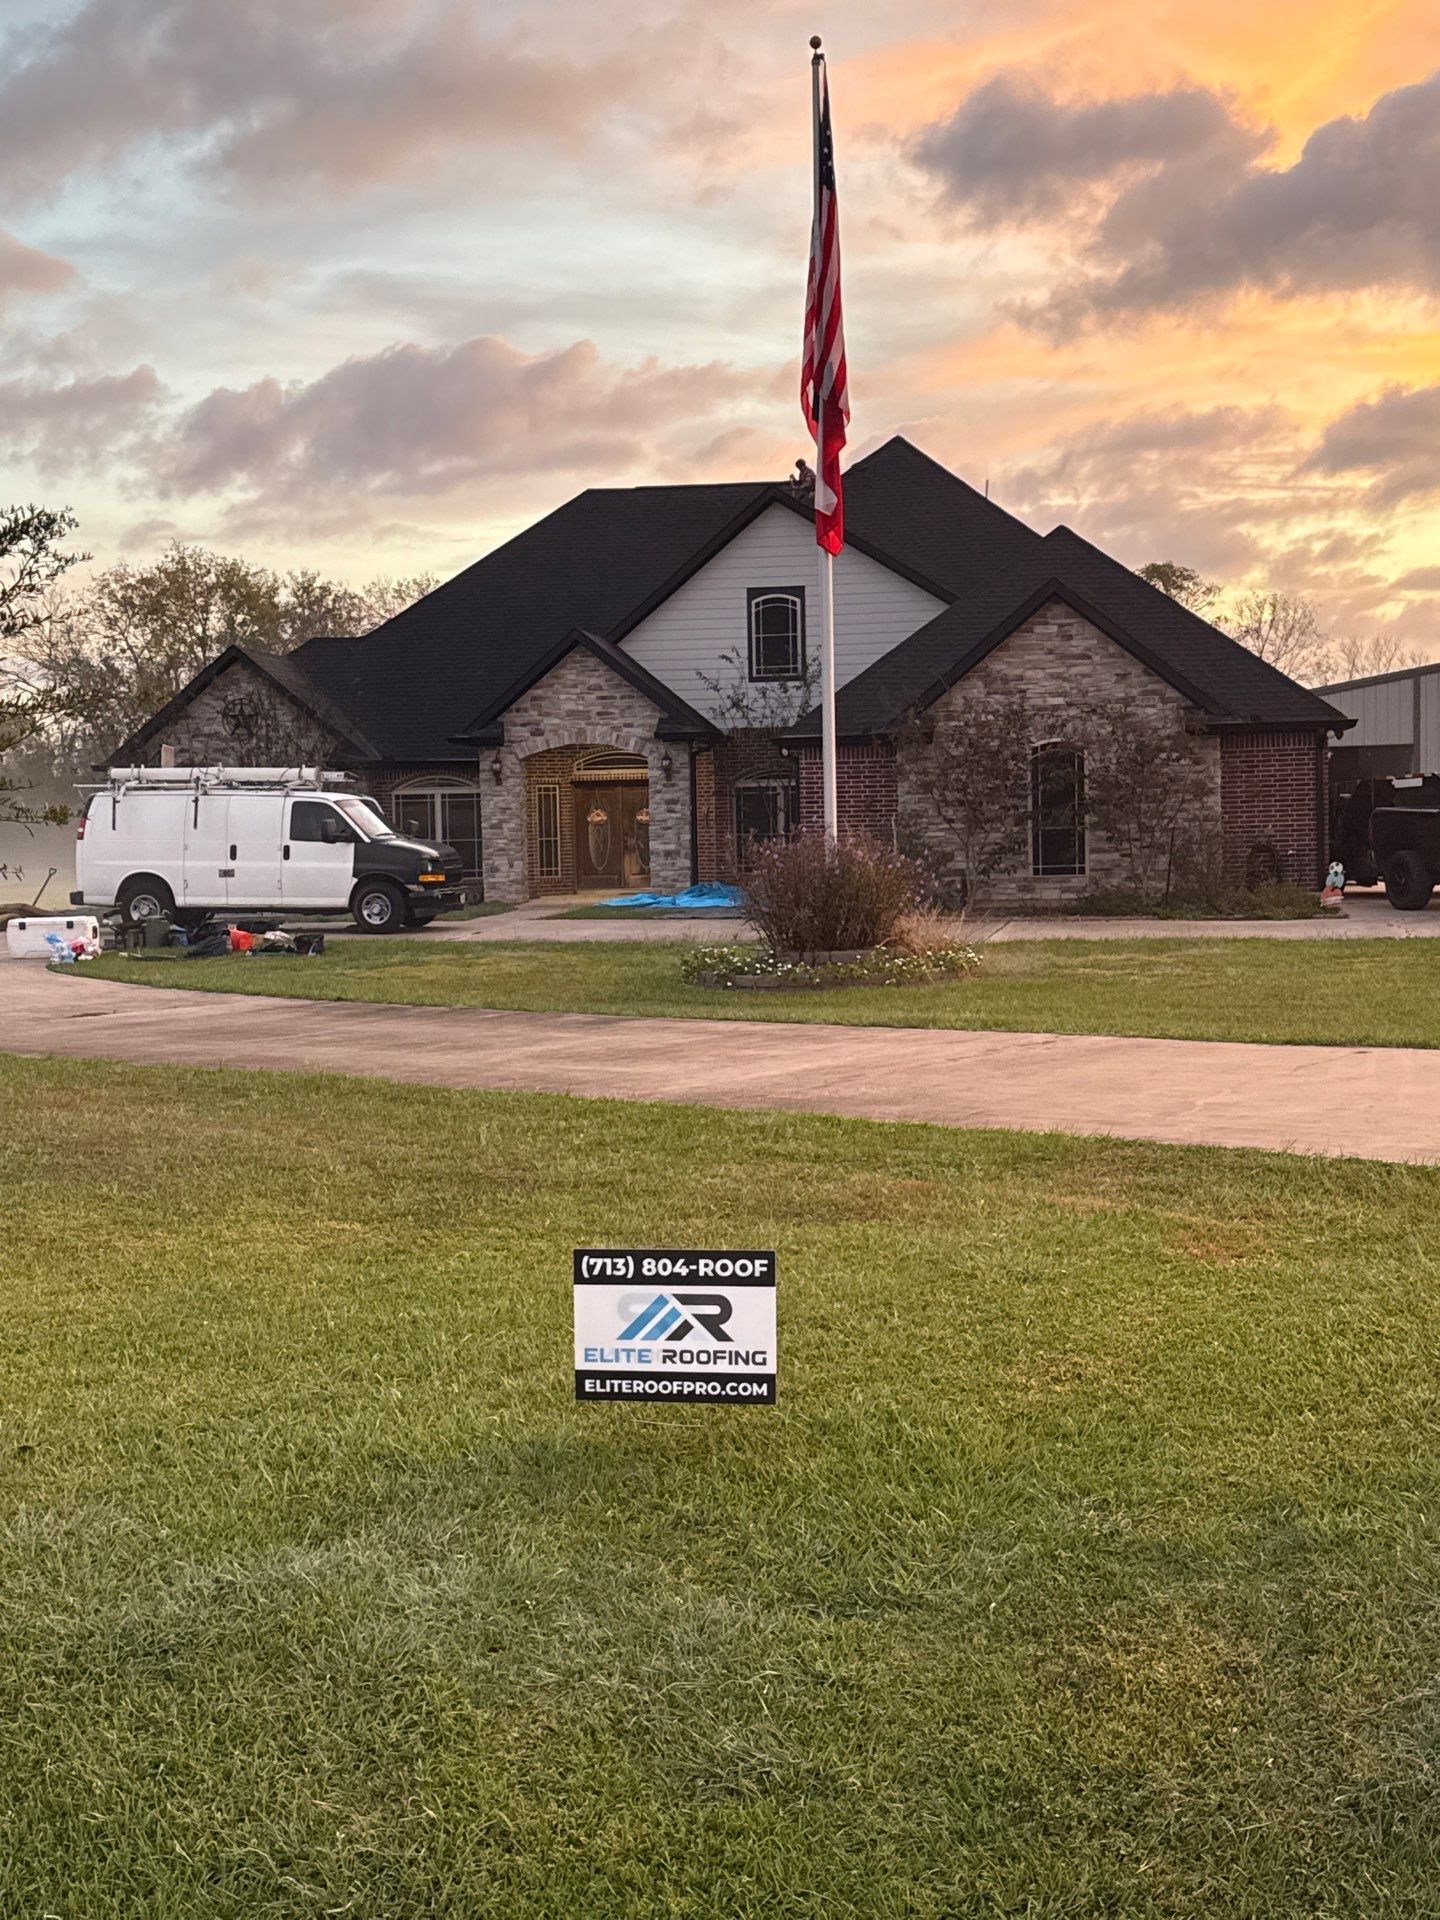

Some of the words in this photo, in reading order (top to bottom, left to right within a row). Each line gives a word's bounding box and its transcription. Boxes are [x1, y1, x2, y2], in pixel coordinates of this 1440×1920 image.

[581, 1255, 635, 1278] (713)
[642, 1258, 769, 1277] 804-ROOF
[584, 1347, 652, 1363] ELITE
[662, 1349, 767, 1366] ROOFING
[584, 1379, 768, 1396] ELITEROOFPRO.COM
